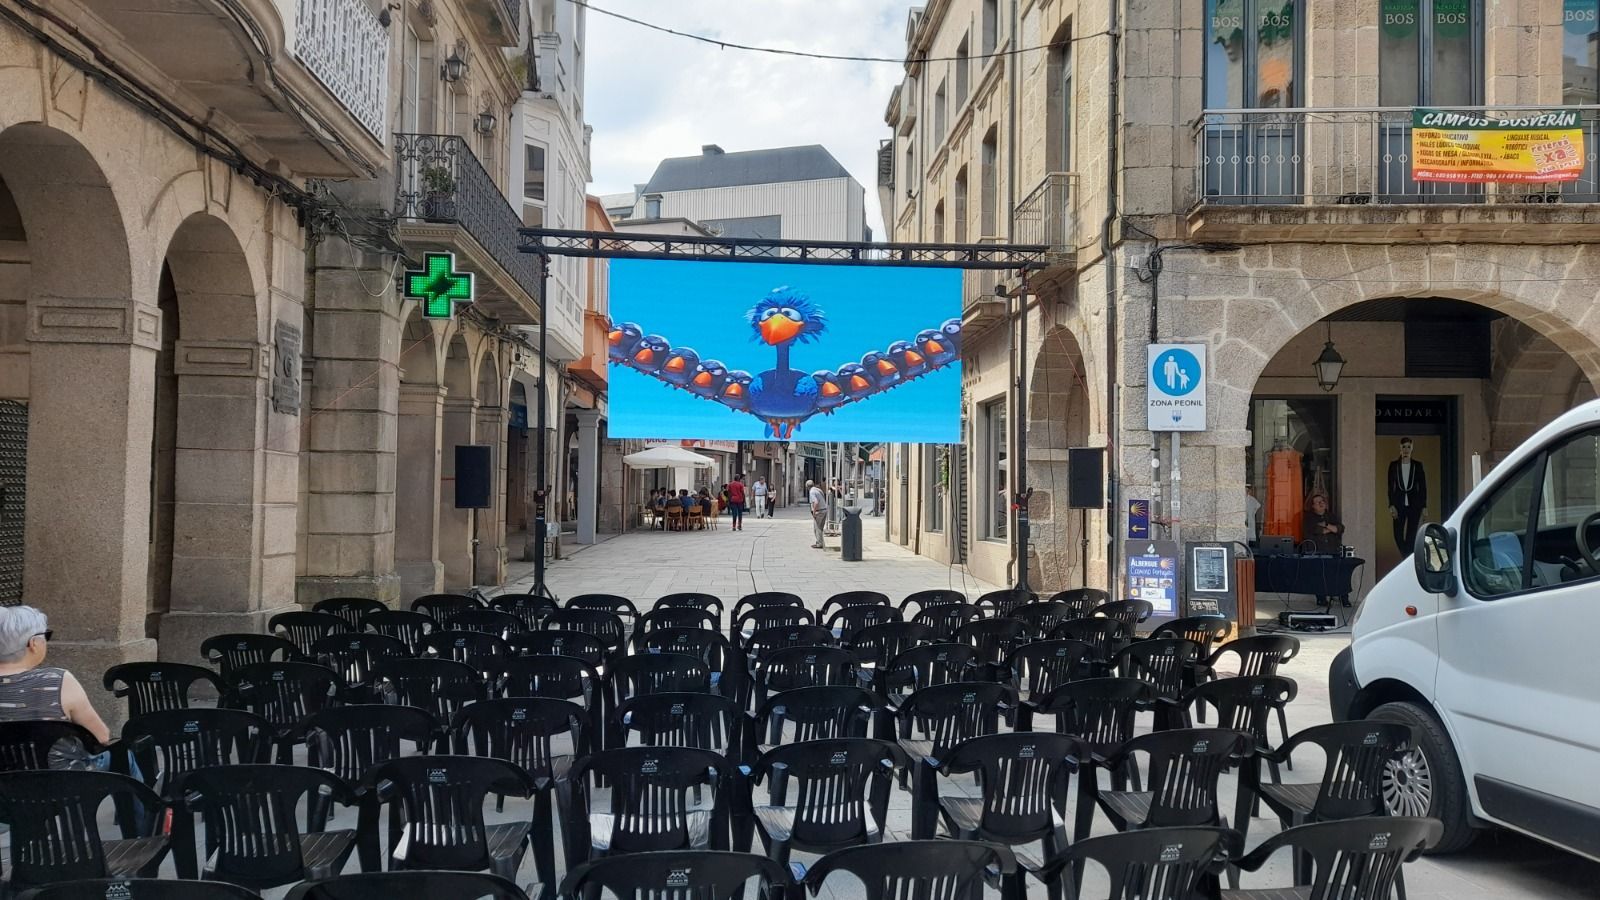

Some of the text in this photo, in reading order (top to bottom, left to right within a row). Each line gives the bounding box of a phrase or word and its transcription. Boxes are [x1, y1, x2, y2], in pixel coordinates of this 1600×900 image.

[1260, 15, 1290, 26] BOS
[1385, 13, 1415, 24] BOS
[1437, 13, 1466, 24] BOS
[1565, 10, 1595, 21] BOS
[1211, 16, 1241, 28] BOS
[1422, 112, 1489, 127] CAMPUS
